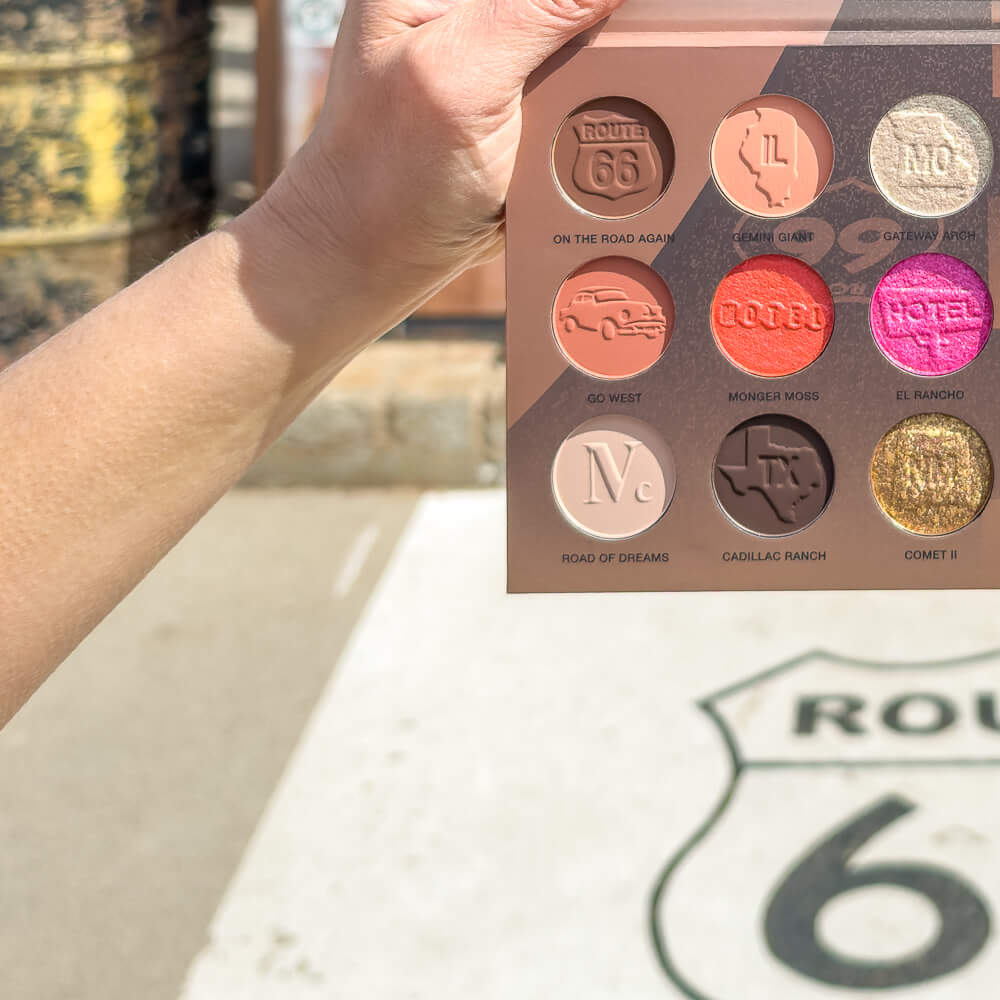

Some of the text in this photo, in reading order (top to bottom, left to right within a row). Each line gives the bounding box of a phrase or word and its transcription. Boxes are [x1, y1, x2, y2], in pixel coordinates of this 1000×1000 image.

[582, 121, 646, 140] ROUTE
[761, 134, 788, 167] IL
[590, 148, 640, 190] 66
[552, 233, 675, 245] ON THE ROAD AGAIN
[731, 231, 815, 243] GEMINI GIANT
[883, 231, 976, 242] GATEWAY ARCH
[588, 393, 642, 404] GO WEST
[728, 391, 820, 402] MONGER MOSS
[896, 390, 965, 401] EL RANCHO
[757, 454, 800, 489] TX
[561, 552, 670, 564] ROAD OF DREAMS
[722, 551, 827, 562] CADILLAC RANCH
[904, 550, 958, 560] COMET II
